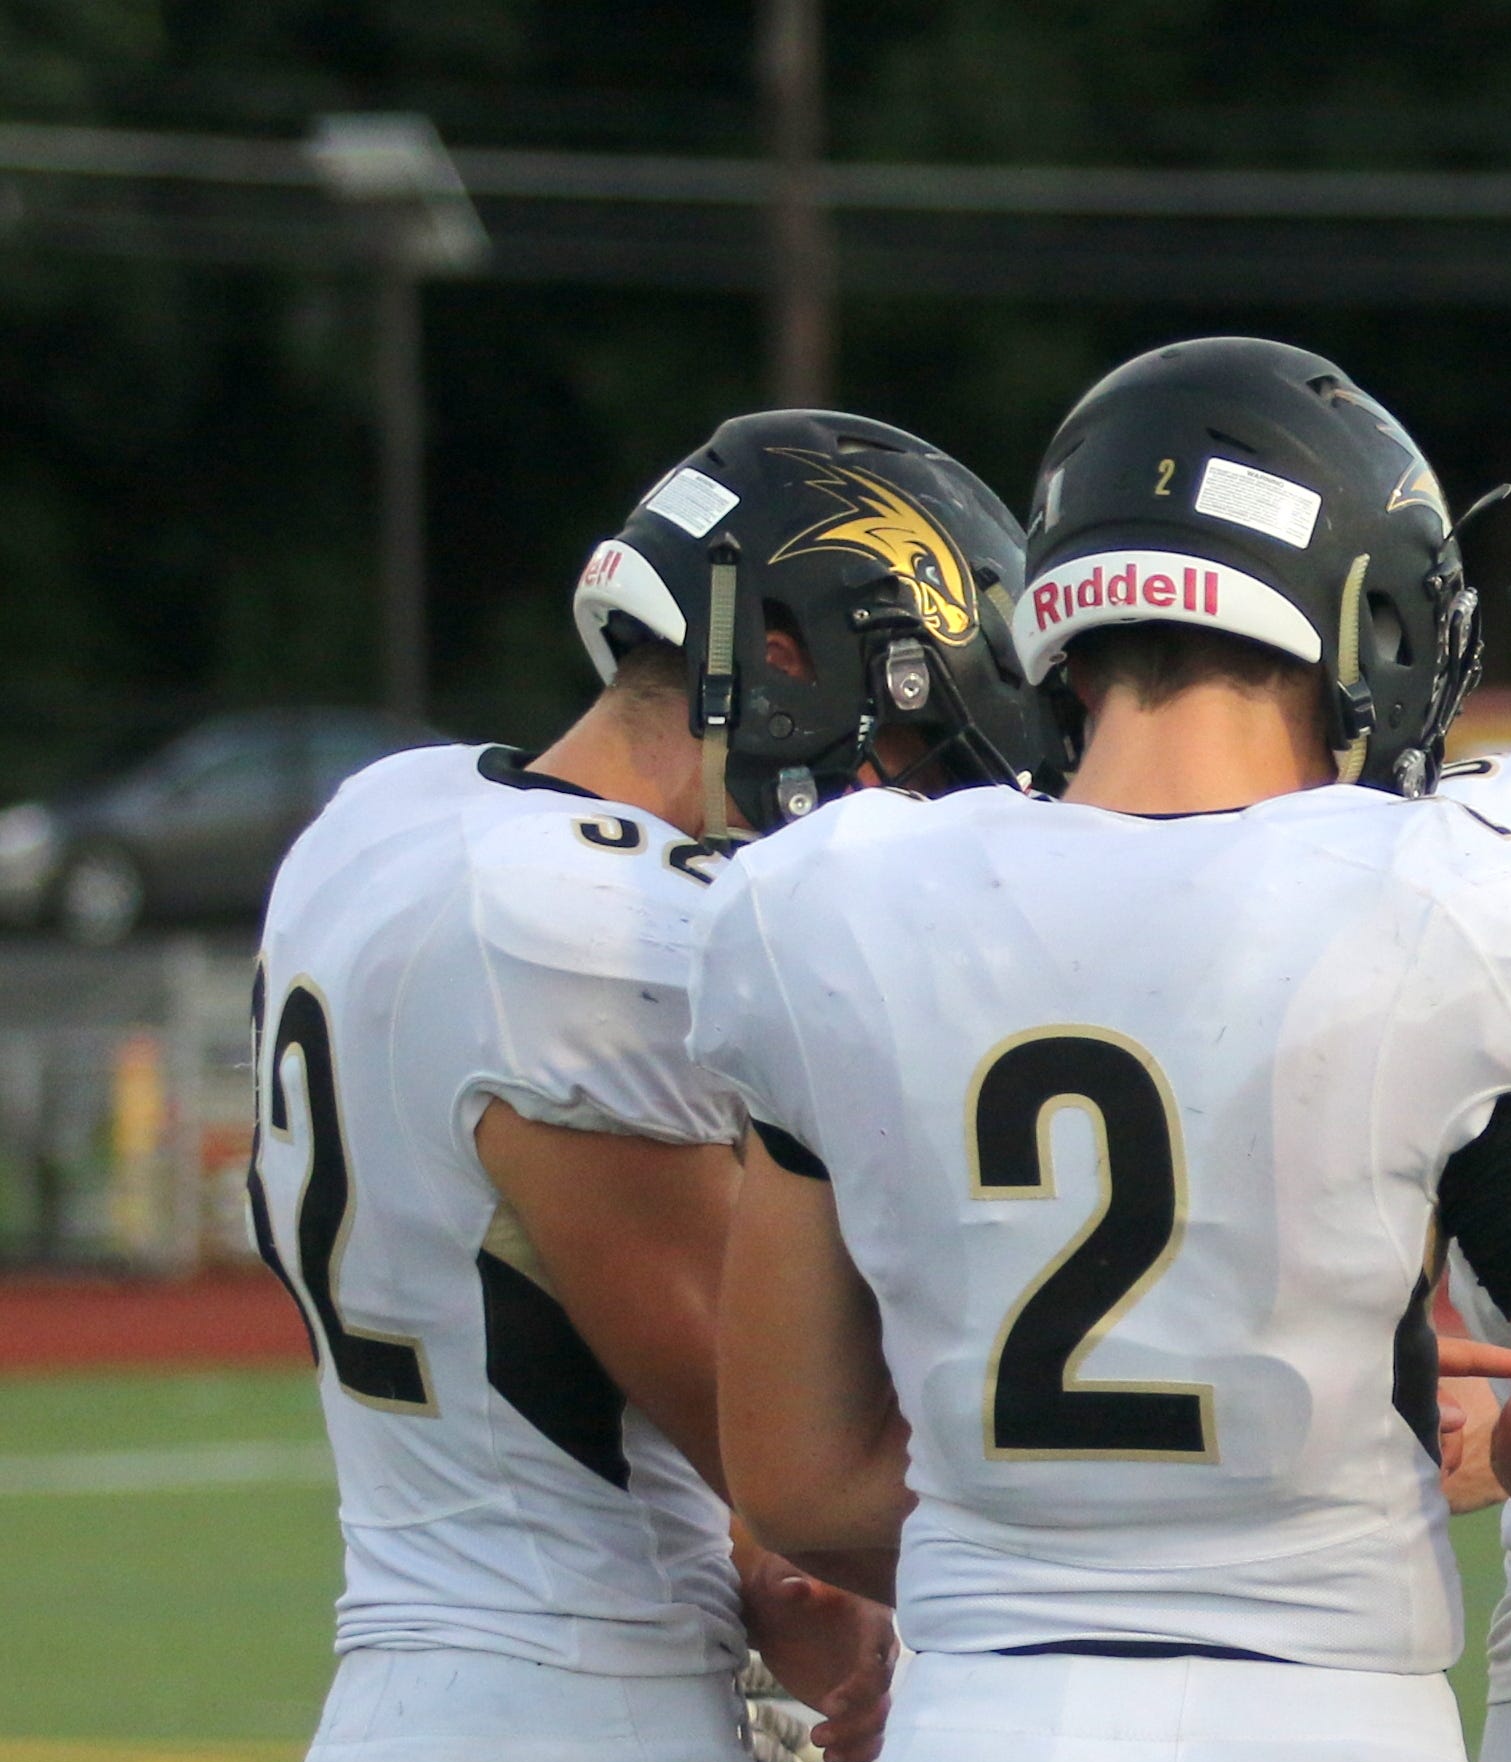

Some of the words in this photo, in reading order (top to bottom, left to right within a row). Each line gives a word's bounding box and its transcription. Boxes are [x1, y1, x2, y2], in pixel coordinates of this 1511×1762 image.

[1033, 563, 1218, 632] Riddell
[1154, 458, 1176, 496] 2
[247, 951, 441, 1419] 2
[966, 1021, 1220, 1465] 2
